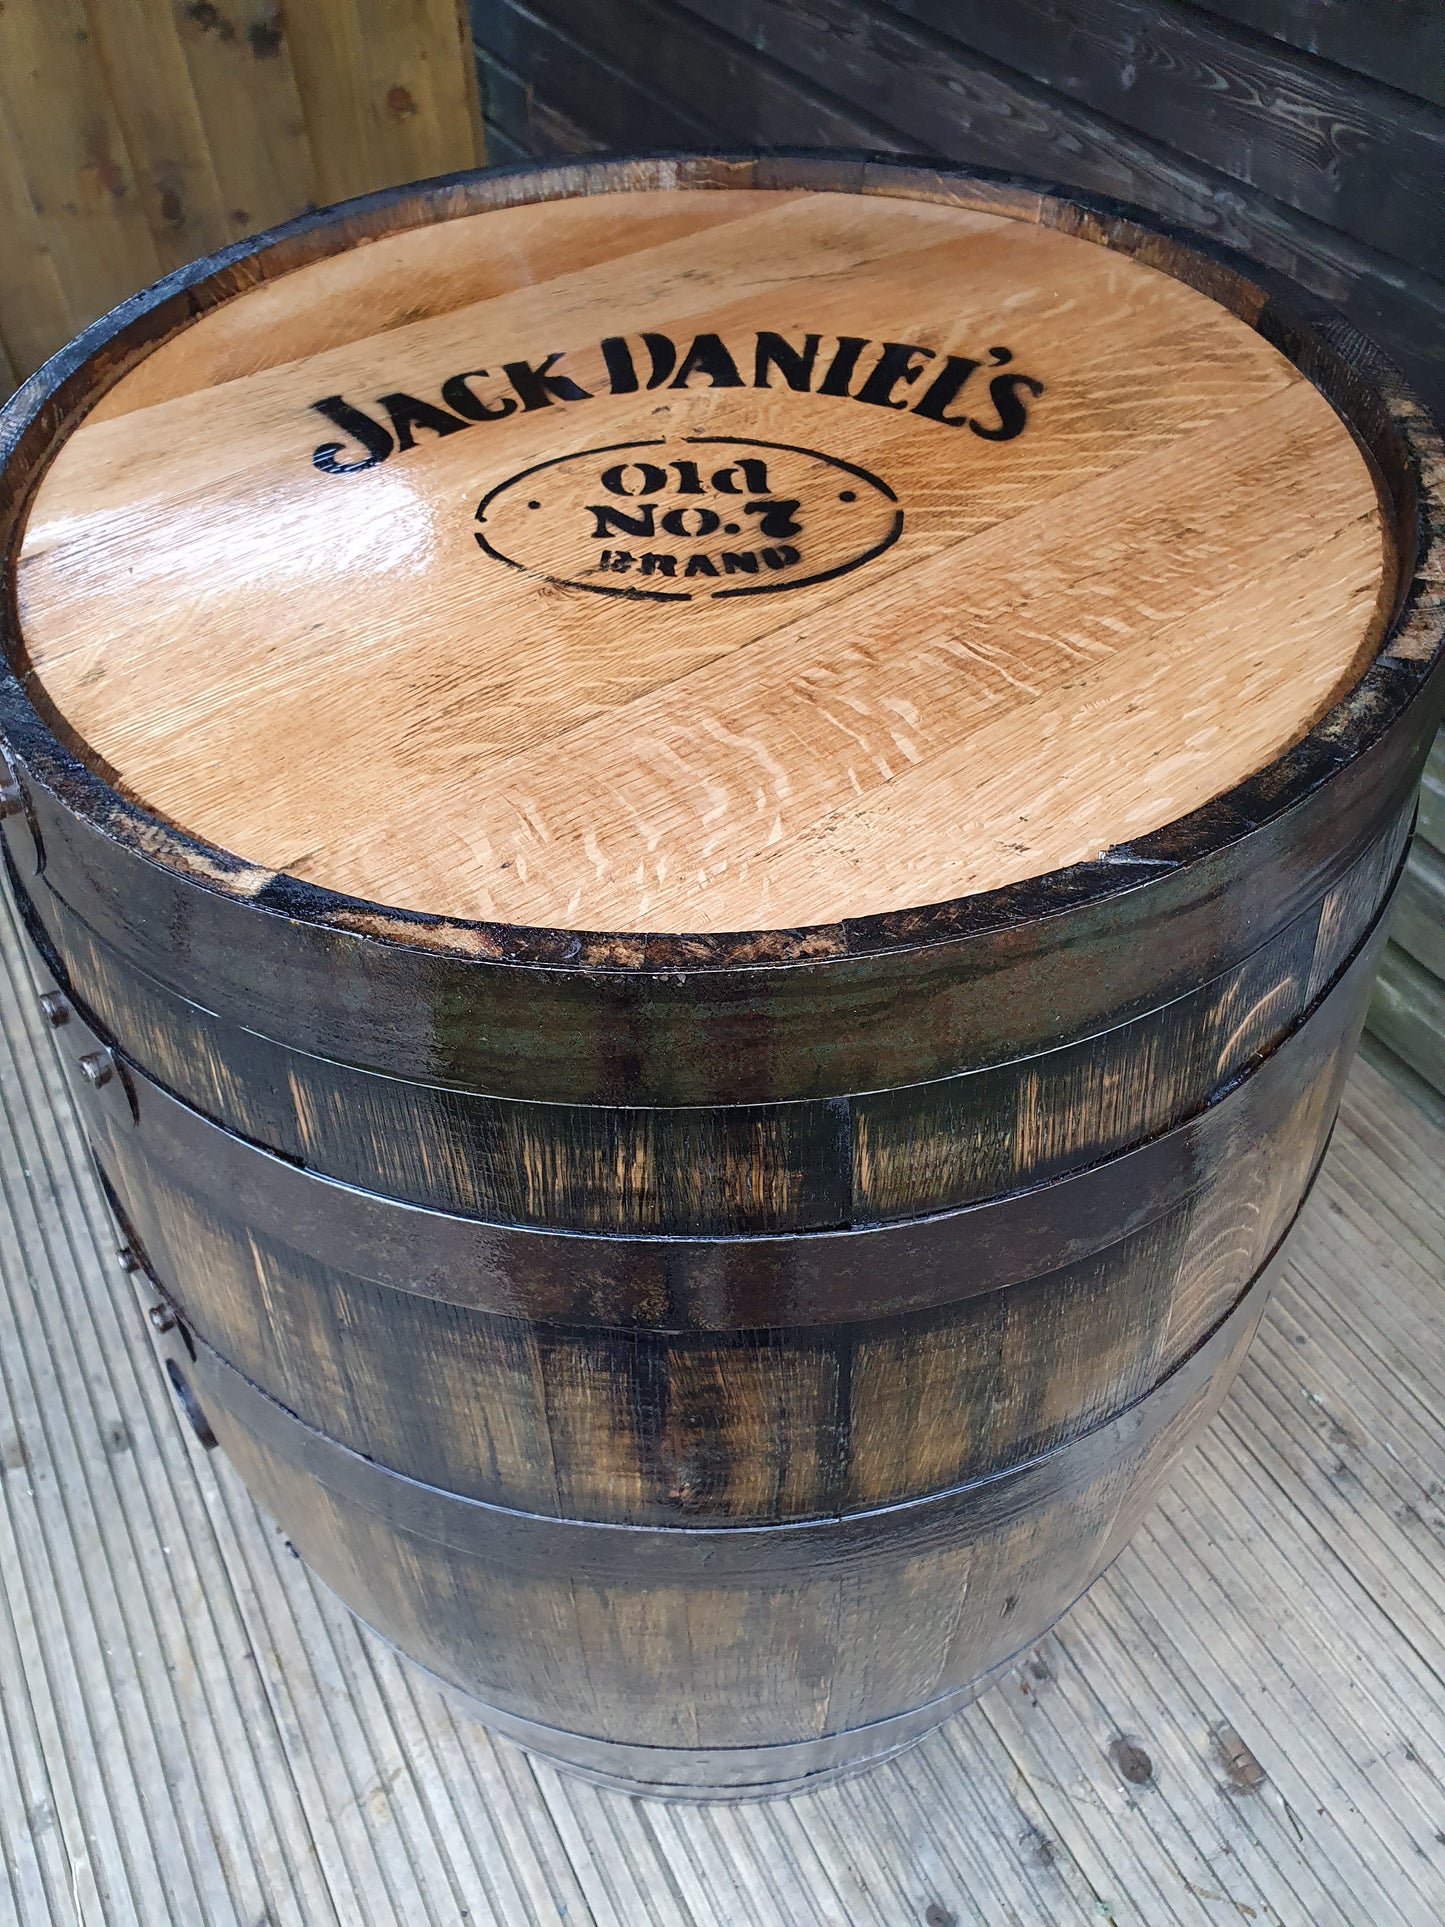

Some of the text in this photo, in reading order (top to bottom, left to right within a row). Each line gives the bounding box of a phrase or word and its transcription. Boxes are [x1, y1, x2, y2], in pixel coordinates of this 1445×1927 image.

[312, 331, 1044, 474] JACK DANIEL'S
[601, 459, 772, 496] Old
[600, 546, 801, 577] BRAND
